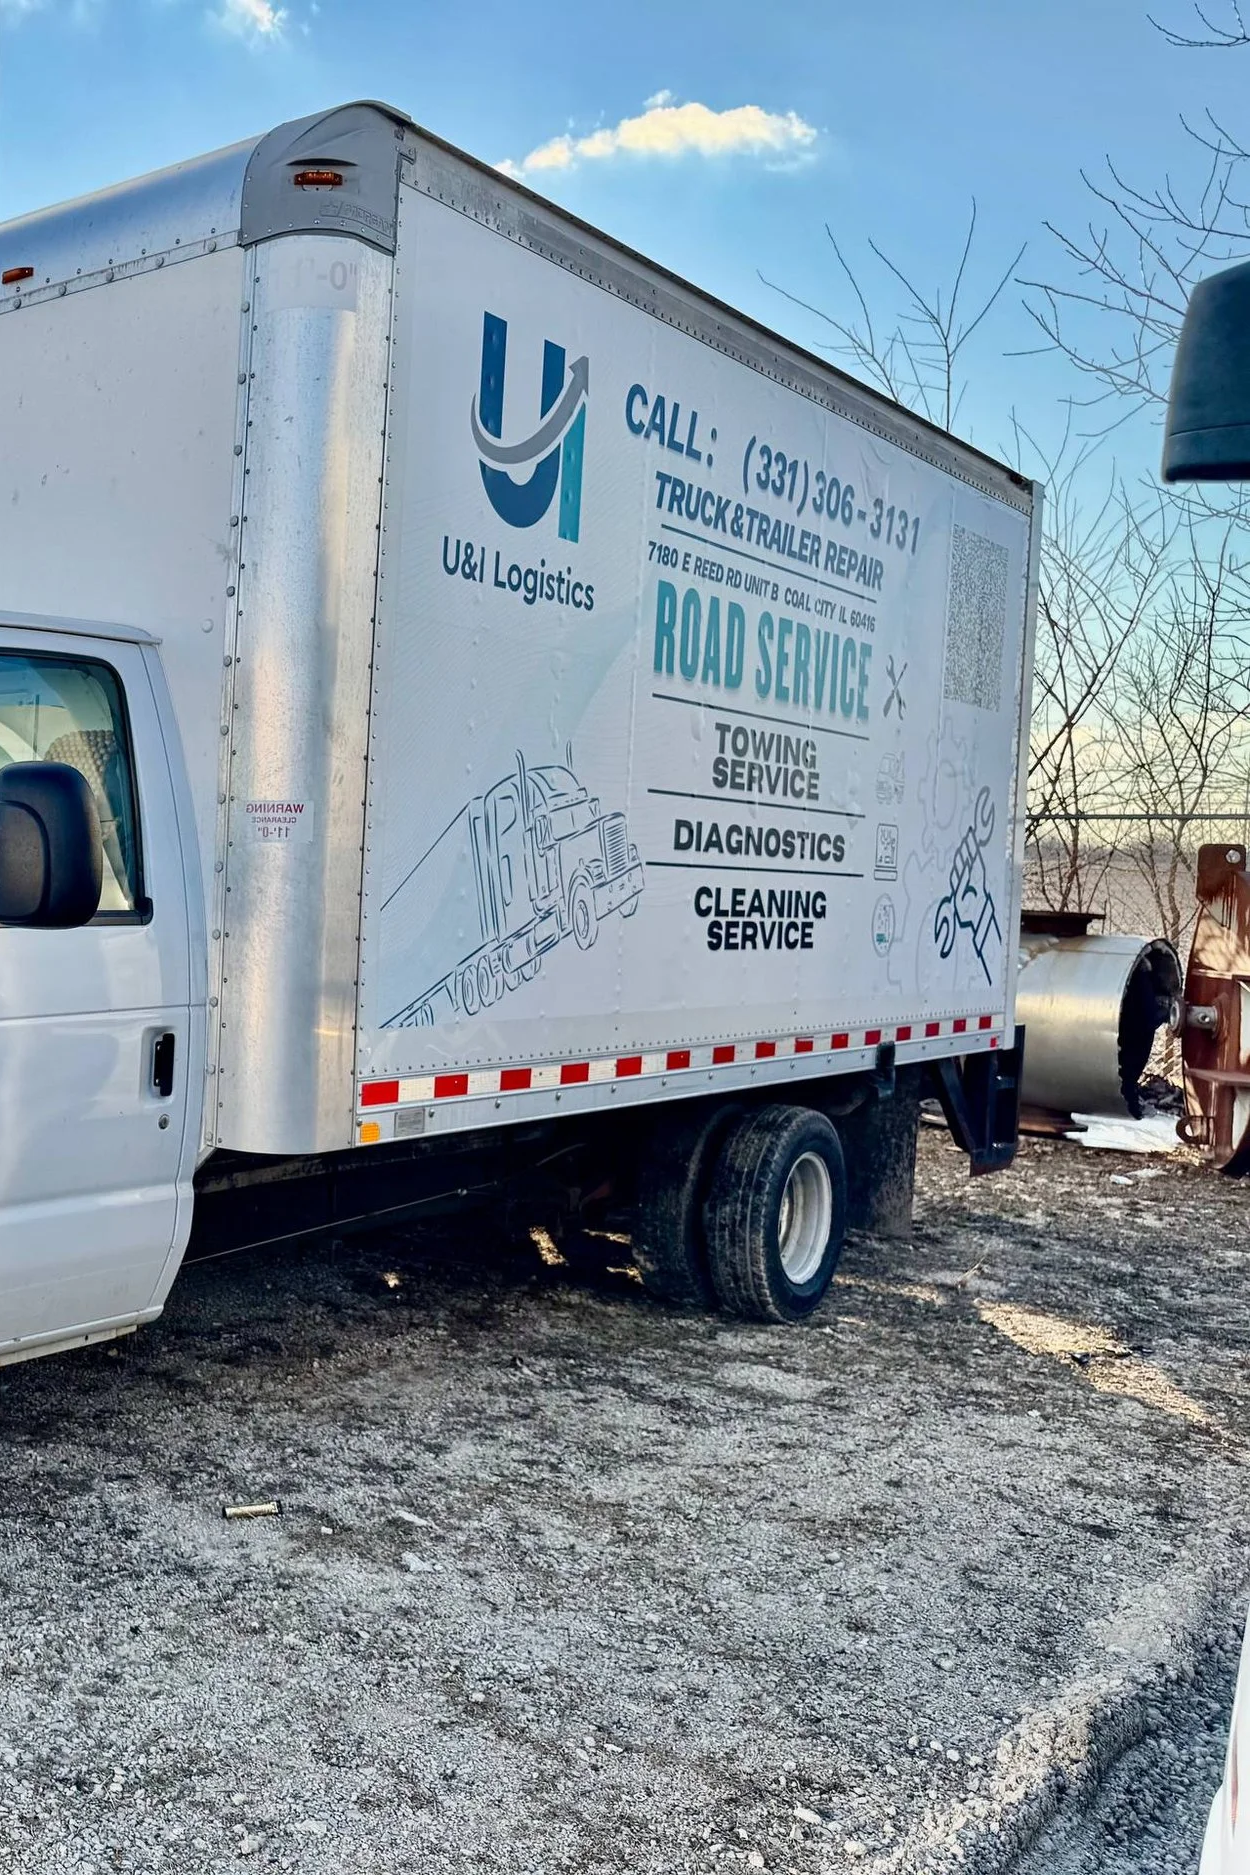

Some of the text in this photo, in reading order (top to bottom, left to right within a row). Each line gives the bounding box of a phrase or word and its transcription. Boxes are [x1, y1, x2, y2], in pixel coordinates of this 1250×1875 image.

[625, 383, 717, 467] CALL:
[442, 535, 595, 611] U&I Logistics
[648, 540, 876, 633] 7180 E REED RD UNIT B COAL CITY IL 60416
[823, 540, 884, 591] REPAIR
[653, 580, 873, 721] ROAD SERVICE
[715, 722, 817, 770] TOWING
[712, 756, 820, 801] SERVICE
[673, 819, 846, 863] DIAGNOSTICS
[694, 886, 827, 919] CLEANING
[707, 920, 814, 951] SERVICE
